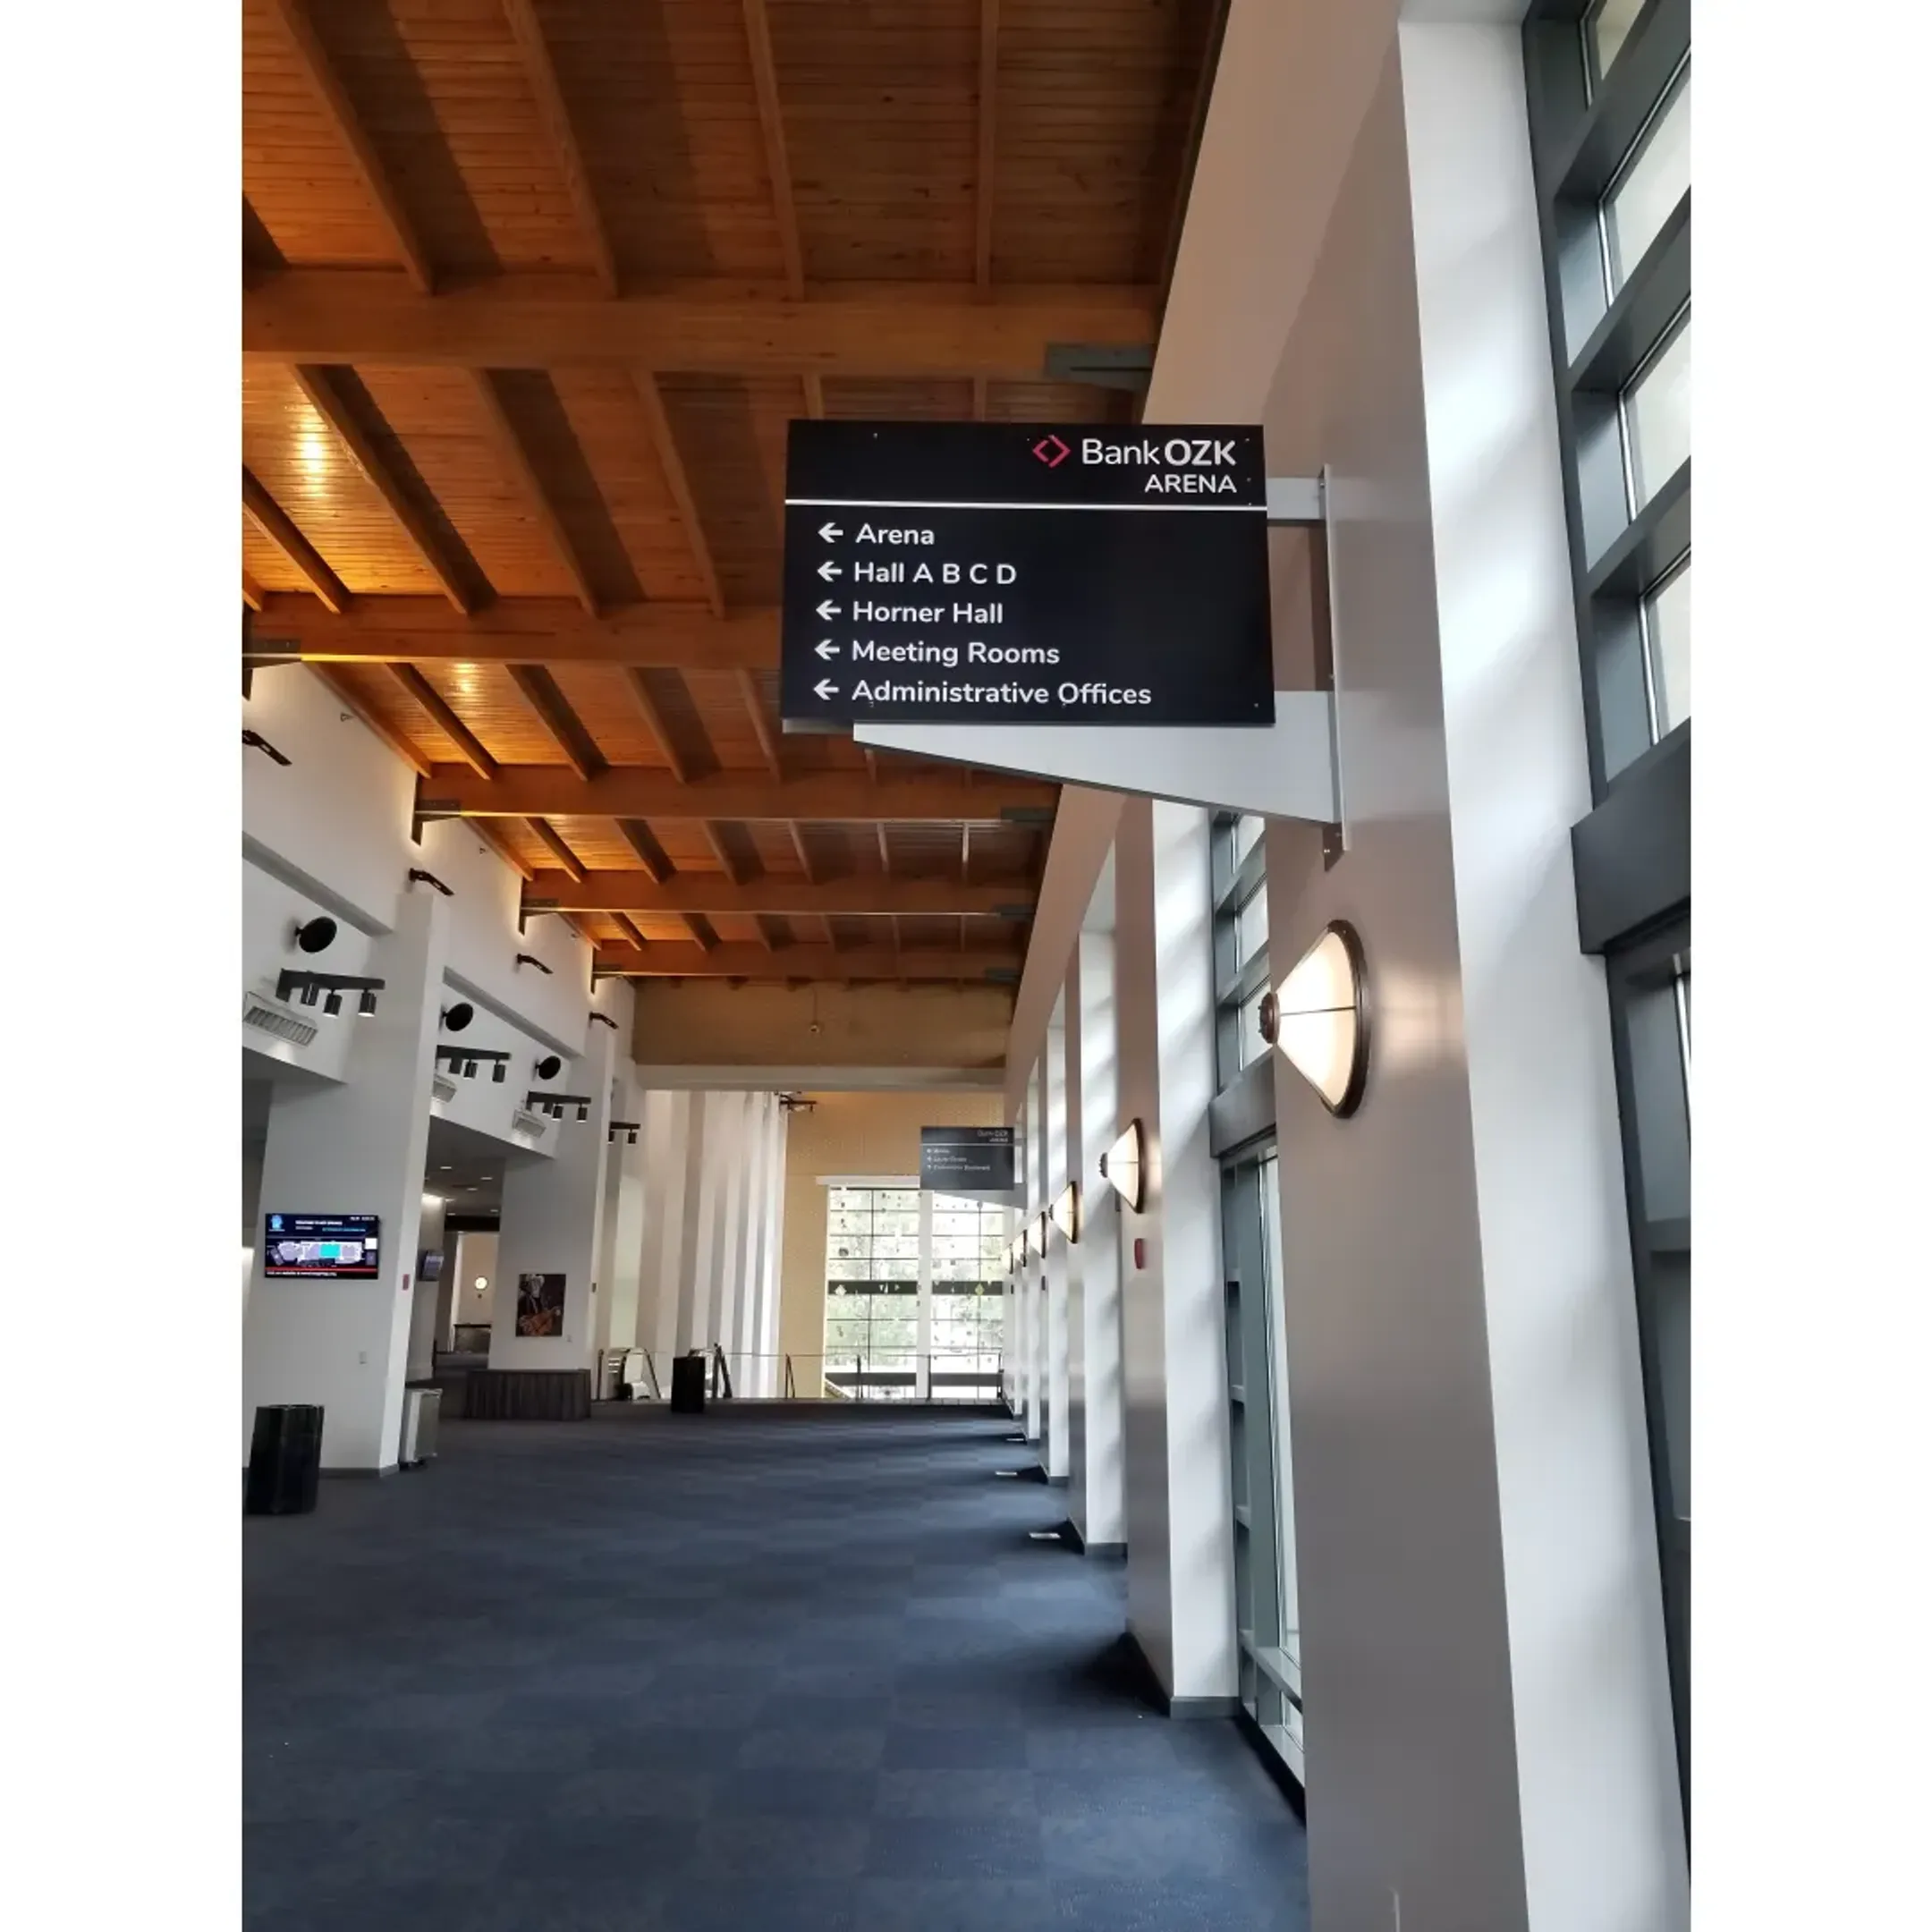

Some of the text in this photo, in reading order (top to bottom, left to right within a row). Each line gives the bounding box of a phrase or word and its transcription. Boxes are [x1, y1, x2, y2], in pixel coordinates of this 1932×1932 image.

[1144, 473, 1238, 494] ARENA
[855, 522, 935, 546] Arena
[854, 561, 1017, 585] Hall A B C D
[852, 600, 1004, 624] Horner Hall
[852, 640, 1060, 668] Meeting Rooms
[851, 679, 1152, 705] Administrative Offices
